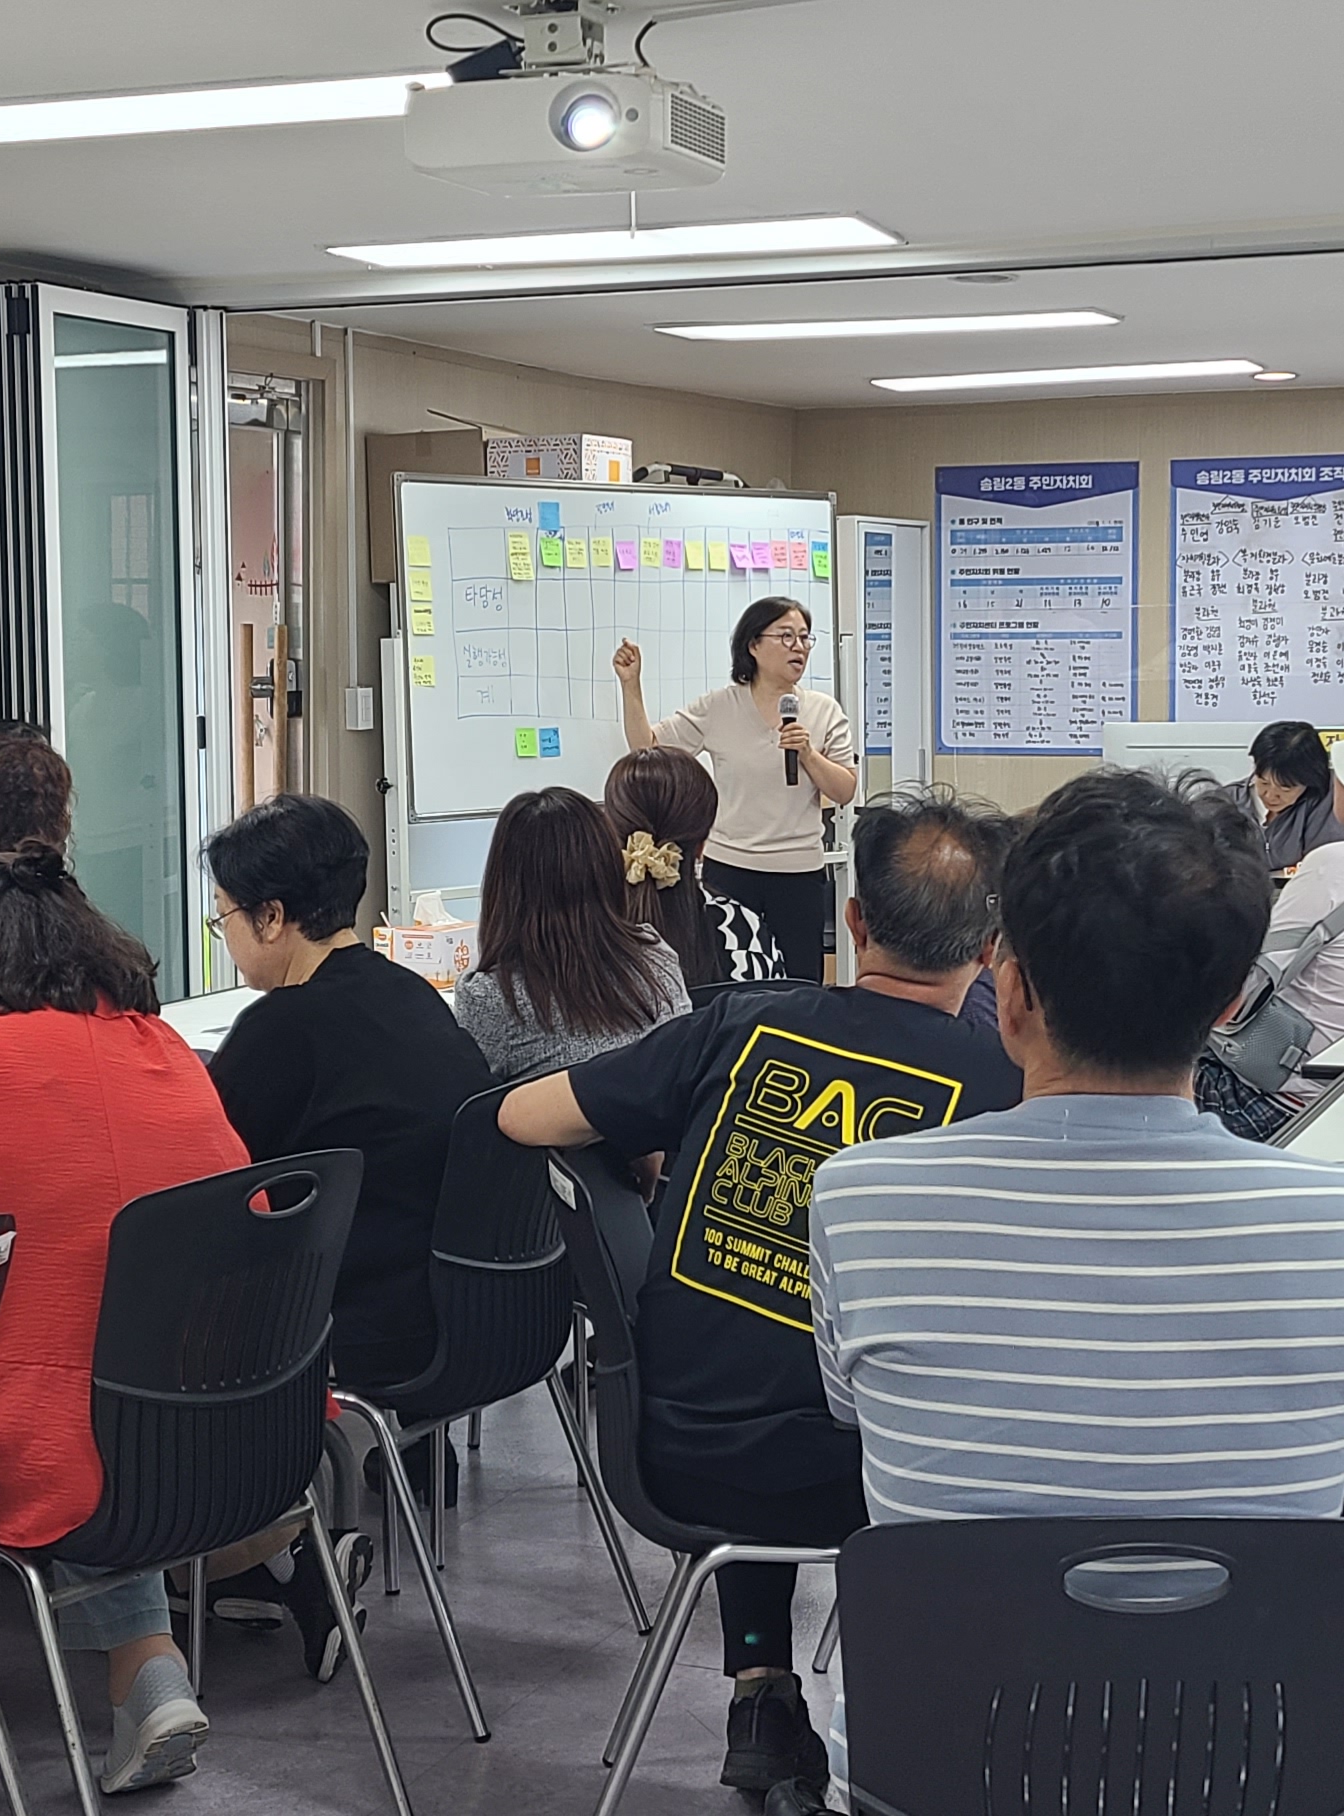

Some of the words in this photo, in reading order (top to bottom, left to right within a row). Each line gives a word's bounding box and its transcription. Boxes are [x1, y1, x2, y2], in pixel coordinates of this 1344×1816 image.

[979, 476, 1026, 492] 송림2동
[1028, 474, 1094, 490] 주민자치회
[1196, 470, 1246, 485] 송림2동
[1247, 467, 1317, 483] 주민자치회
[464, 583, 504, 612] 타당성
[745, 1058, 925, 1146] BAC
[711, 1177, 794, 1227] CLUB
[715, 1155, 813, 1210] ALPIN
[703, 1227, 723, 1247] 100
[724, 1234, 773, 1264] SUMMIT
[773, 1252, 811, 1280] CHALL
[707, 1247, 723, 1266] TO
[723, 1254, 741, 1273] BE
[741, 1261, 779, 1287] GREAT
[778, 1275, 813, 1301] ALPIN
